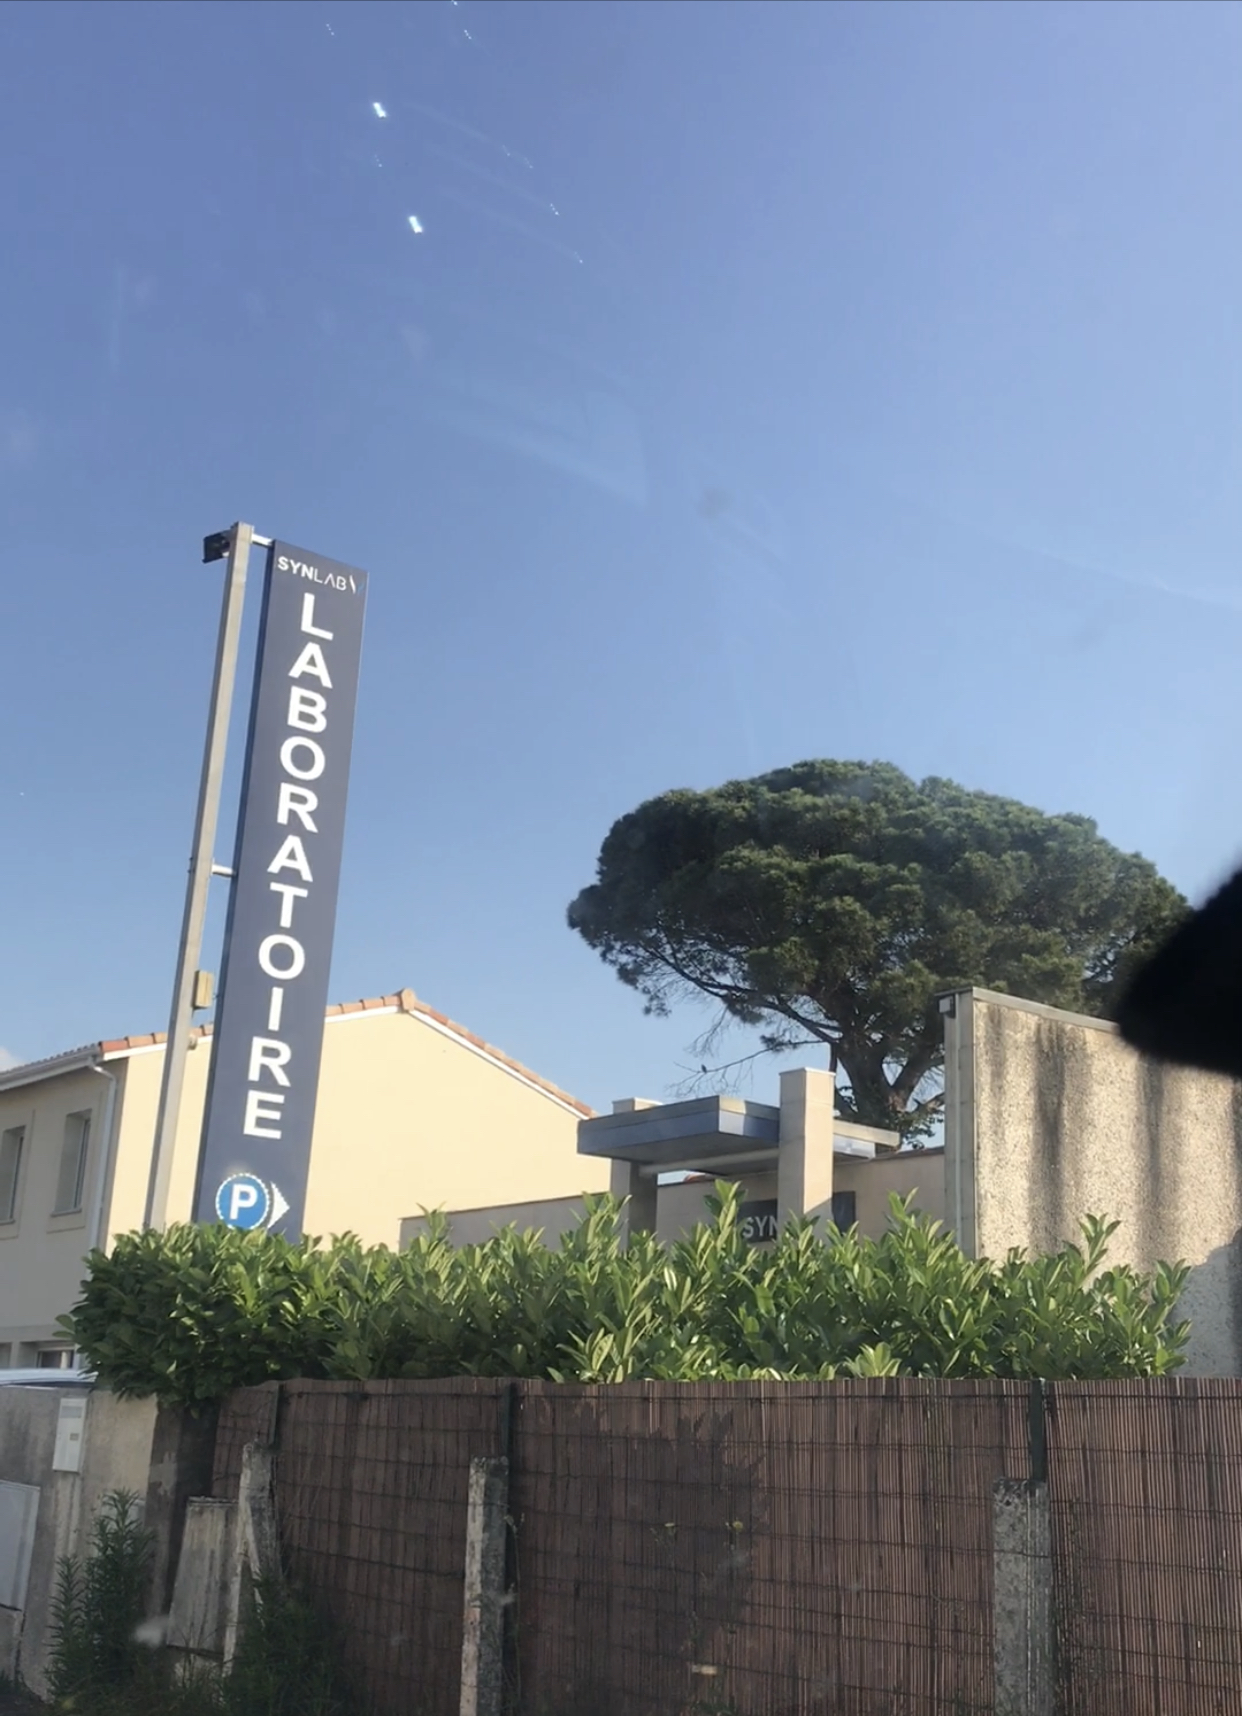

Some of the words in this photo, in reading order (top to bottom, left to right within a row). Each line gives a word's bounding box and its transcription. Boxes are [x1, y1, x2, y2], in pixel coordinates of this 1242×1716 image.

[277, 556, 347, 591] SYNLAB
[243, 592, 334, 1140] LABORATOIRE
[229, 1183, 258, 1220] P
